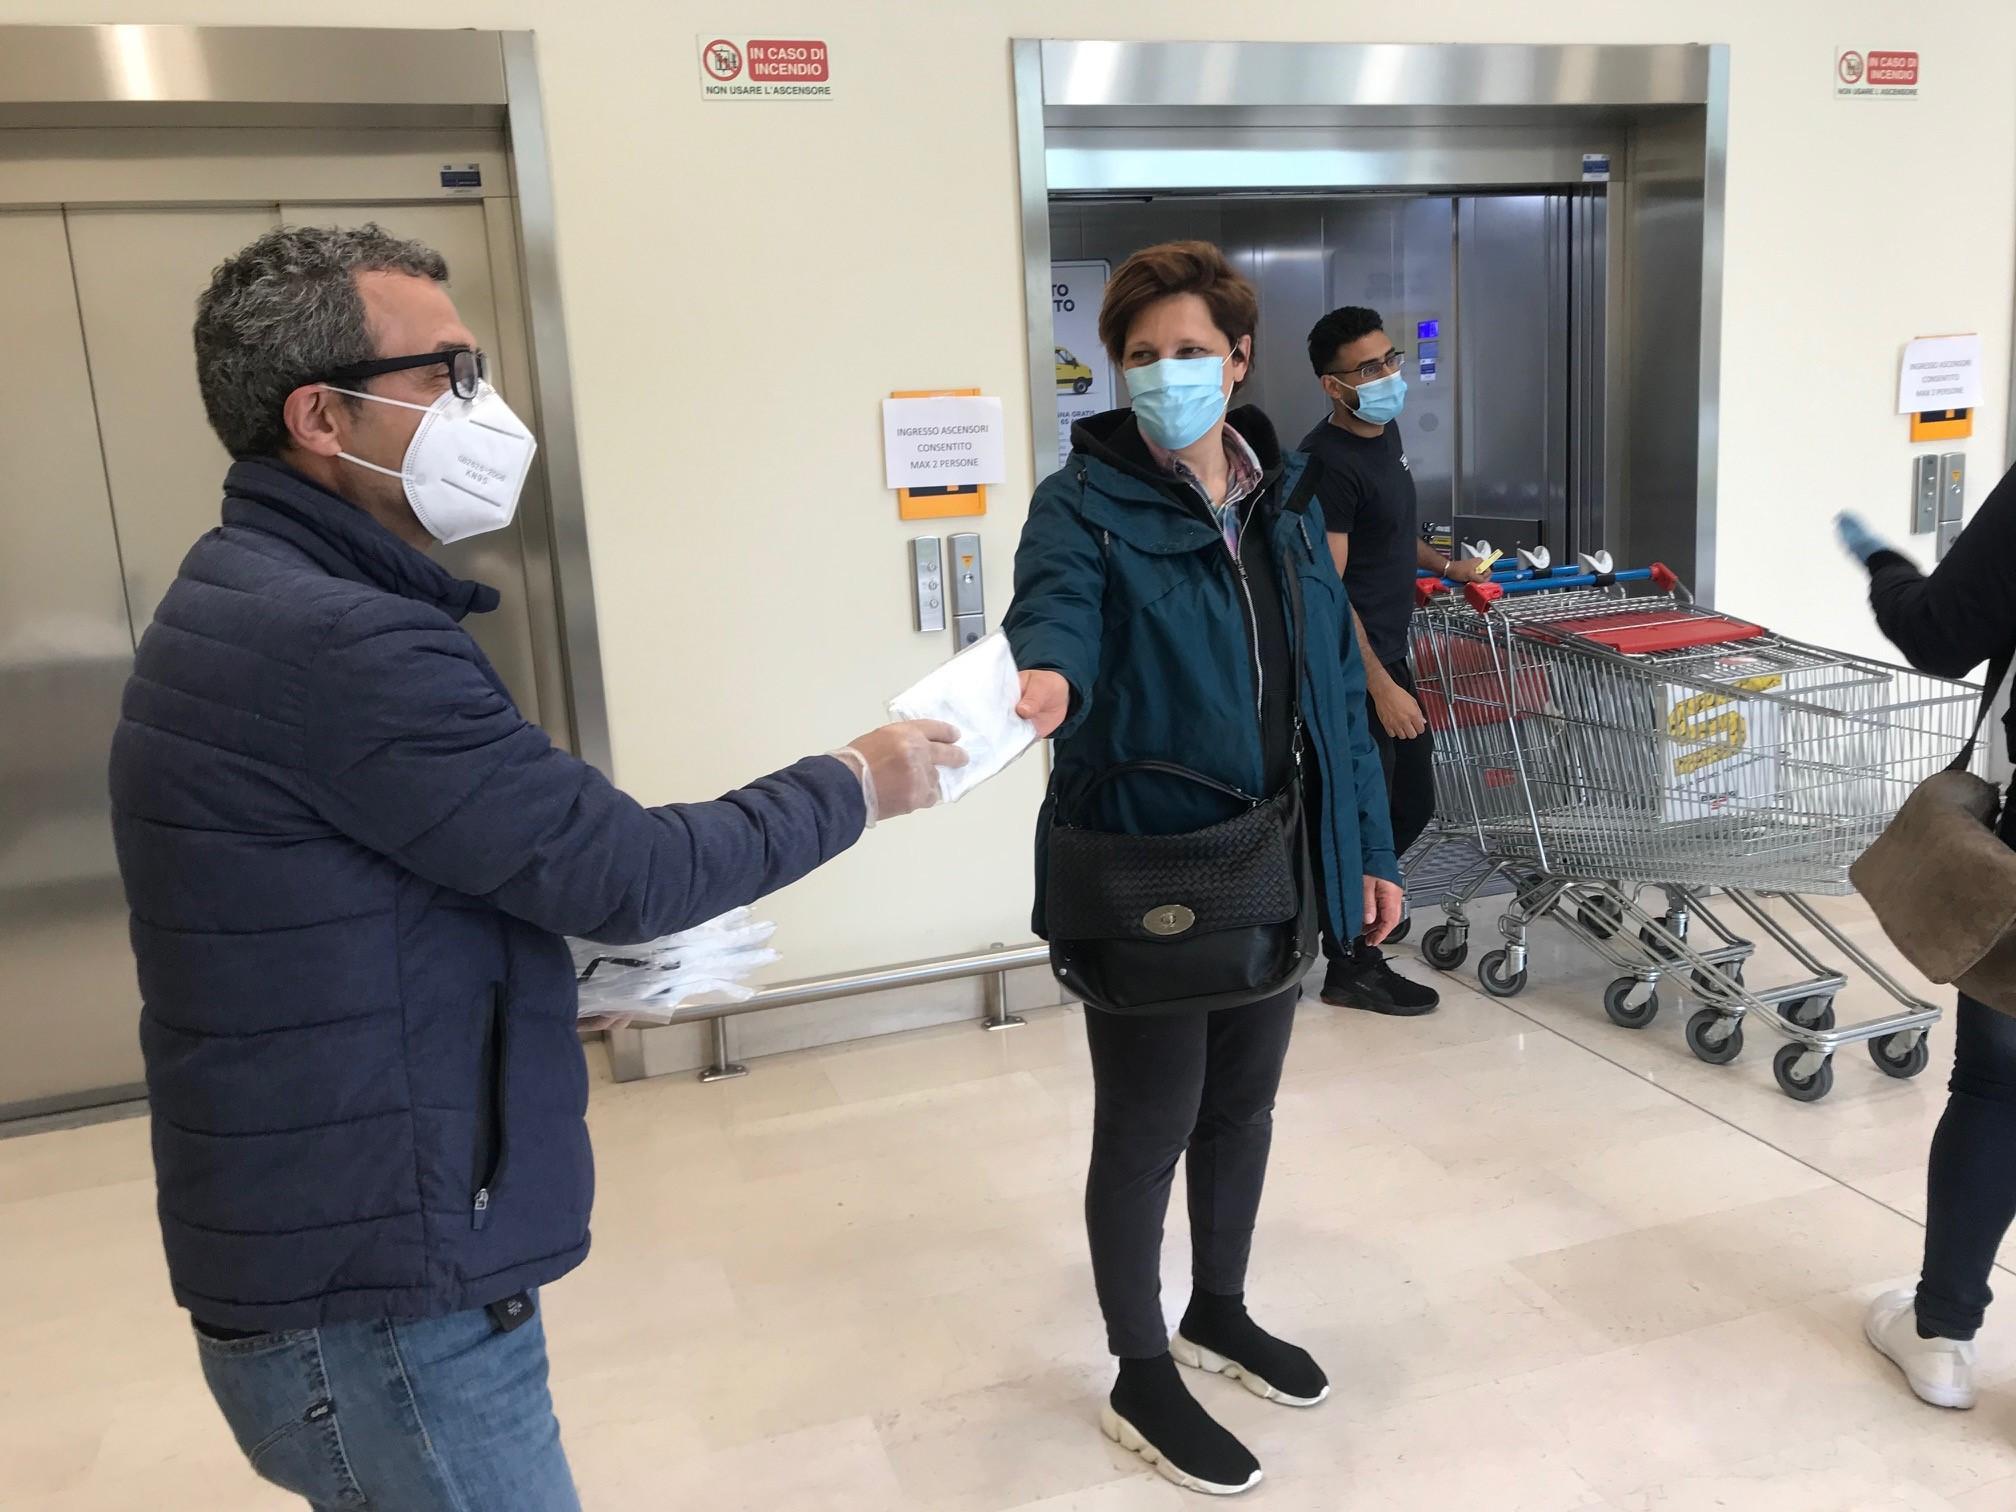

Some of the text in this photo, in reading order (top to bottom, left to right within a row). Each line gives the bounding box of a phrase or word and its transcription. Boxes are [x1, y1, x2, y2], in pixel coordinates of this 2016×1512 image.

[750, 48, 824, 60] IN CASO DI
[1869, 57, 1917, 67] IN CASO DI
[755, 63, 822, 75] INCENDIO
[1871, 70, 1914, 79] INCENDIO
[706, 86, 831, 95] NON USARE L'ASCENSORE
[897, 425, 989, 437] INGRESSO ASCENSORI
[917, 442, 972, 452] CONSENTITO
[910, 458, 979, 469] MAX 2 PERSONE
